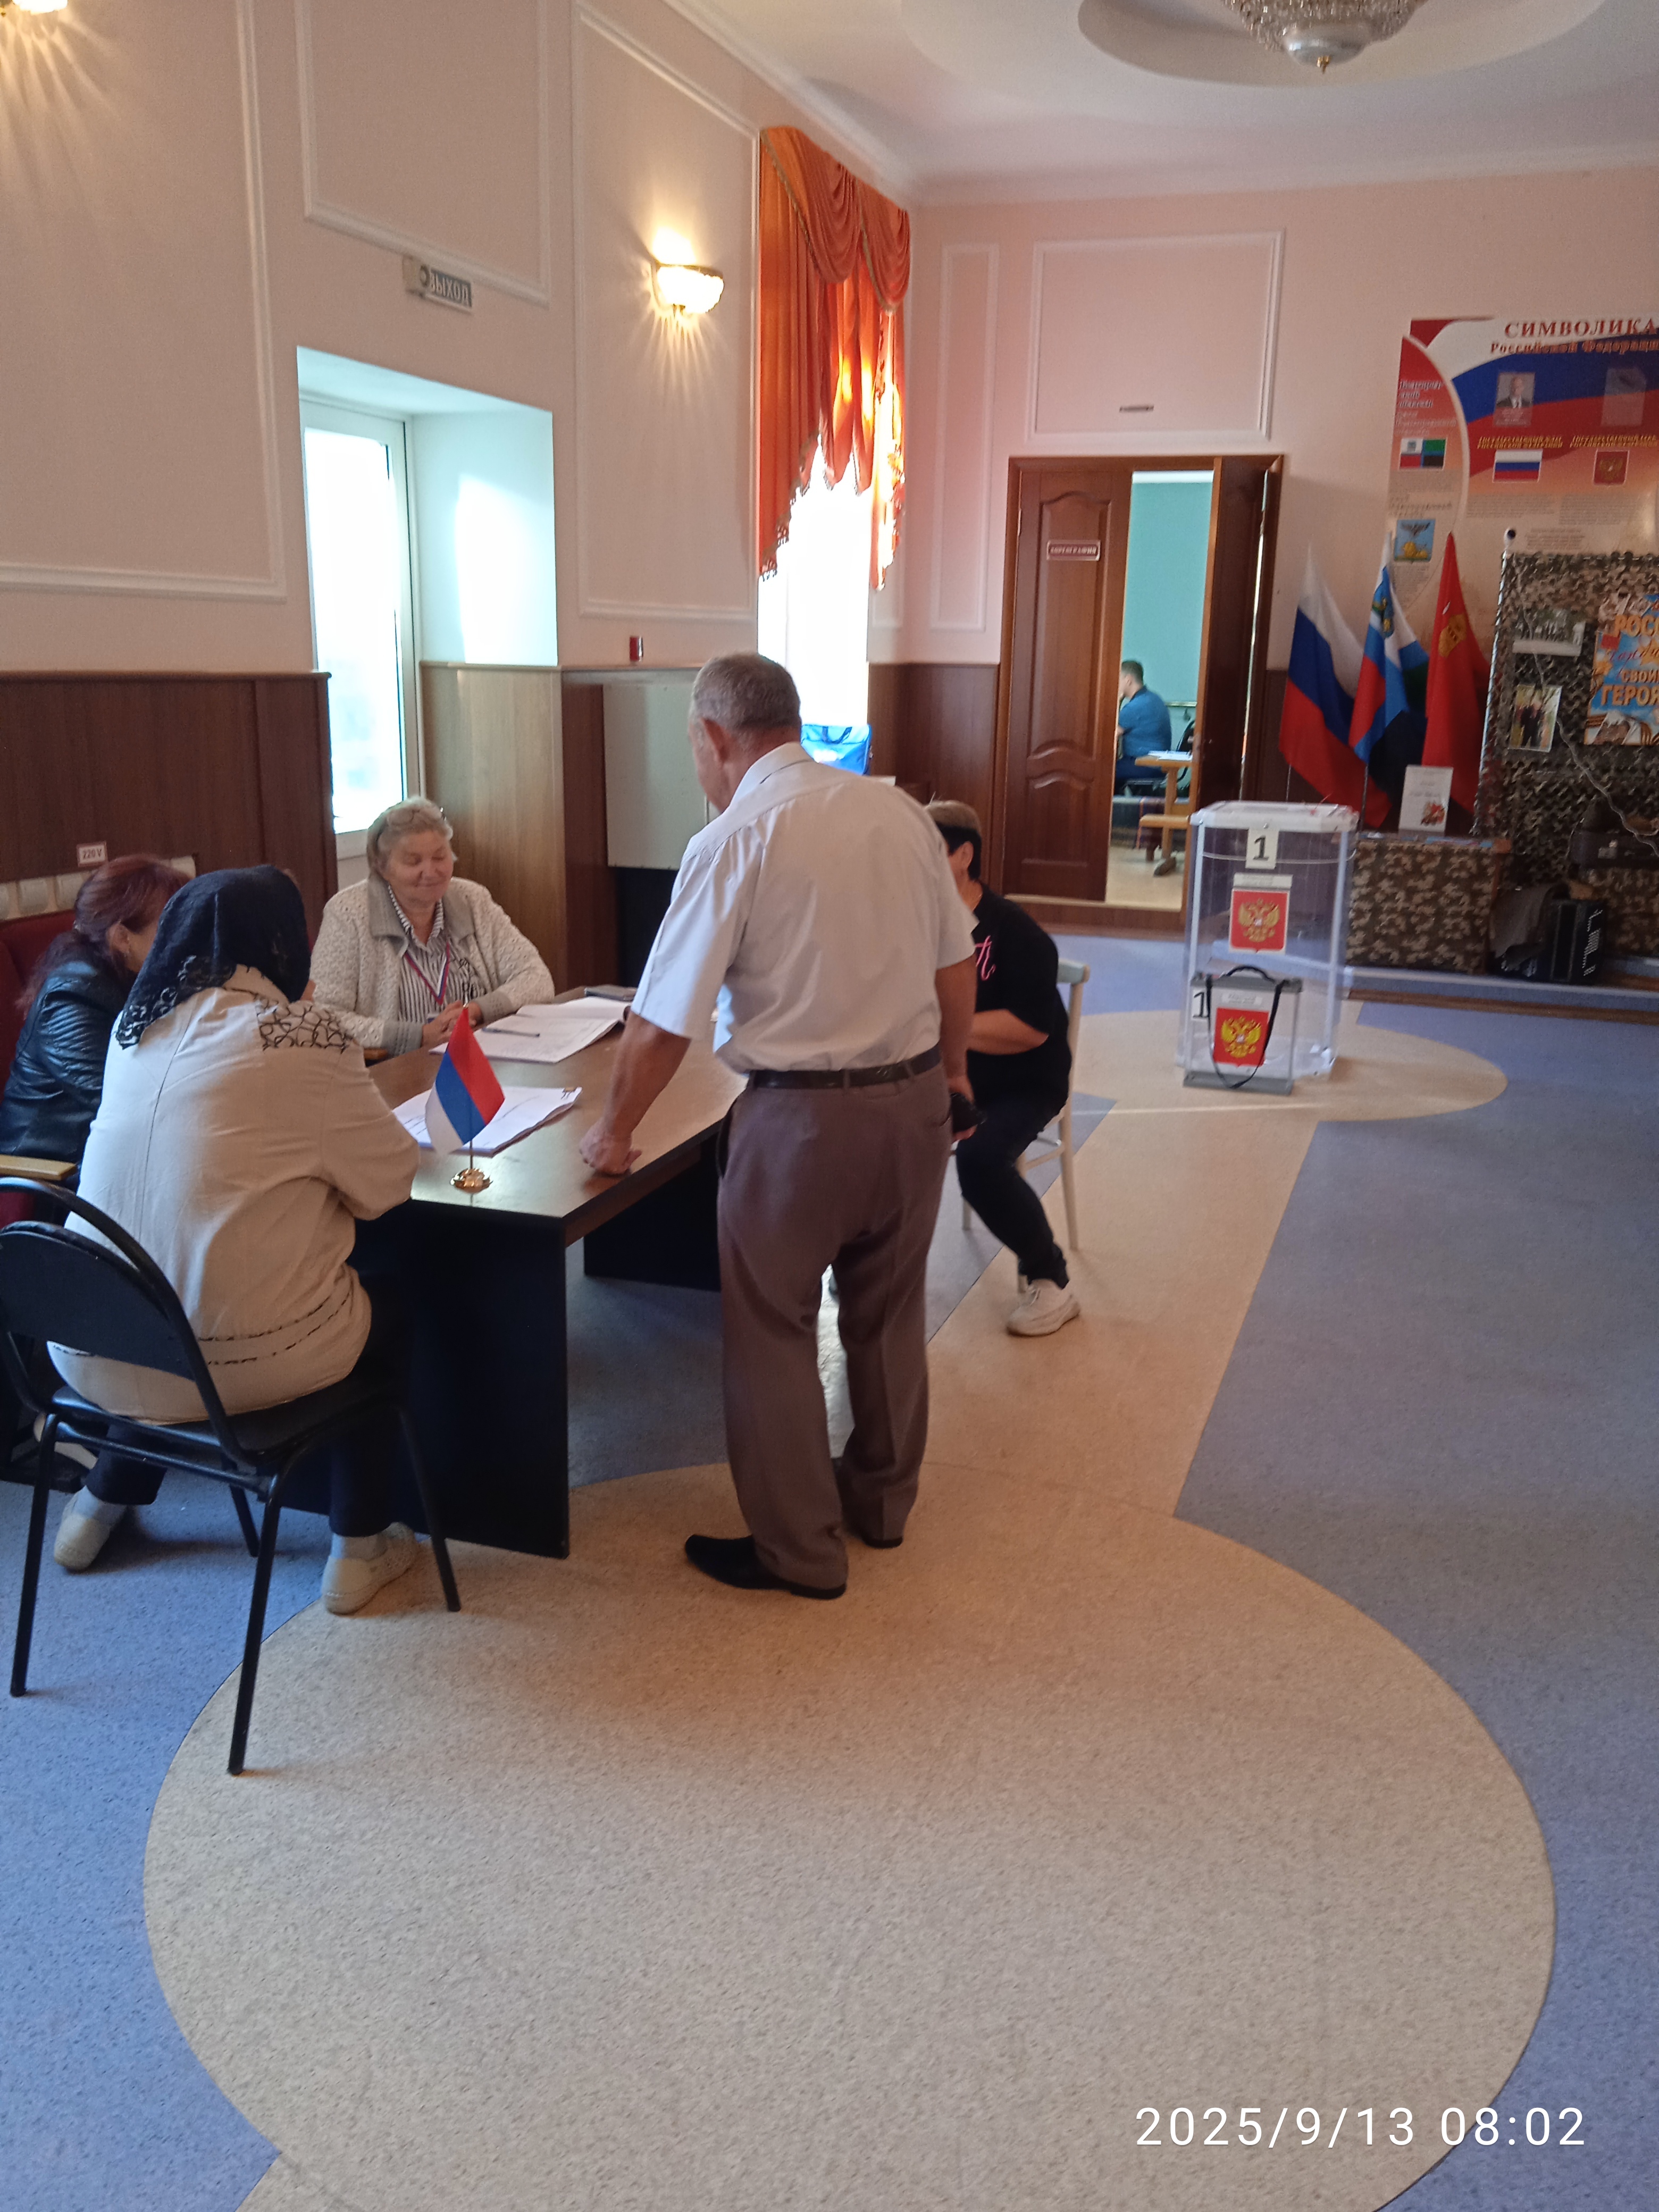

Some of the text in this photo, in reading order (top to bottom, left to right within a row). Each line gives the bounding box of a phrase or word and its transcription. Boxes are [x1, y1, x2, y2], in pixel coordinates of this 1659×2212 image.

[1505, 319, 1657, 338] СИМВОЛИКА
[1253, 834, 1269, 861] 1
[1193, 992, 1209, 1018] 1
